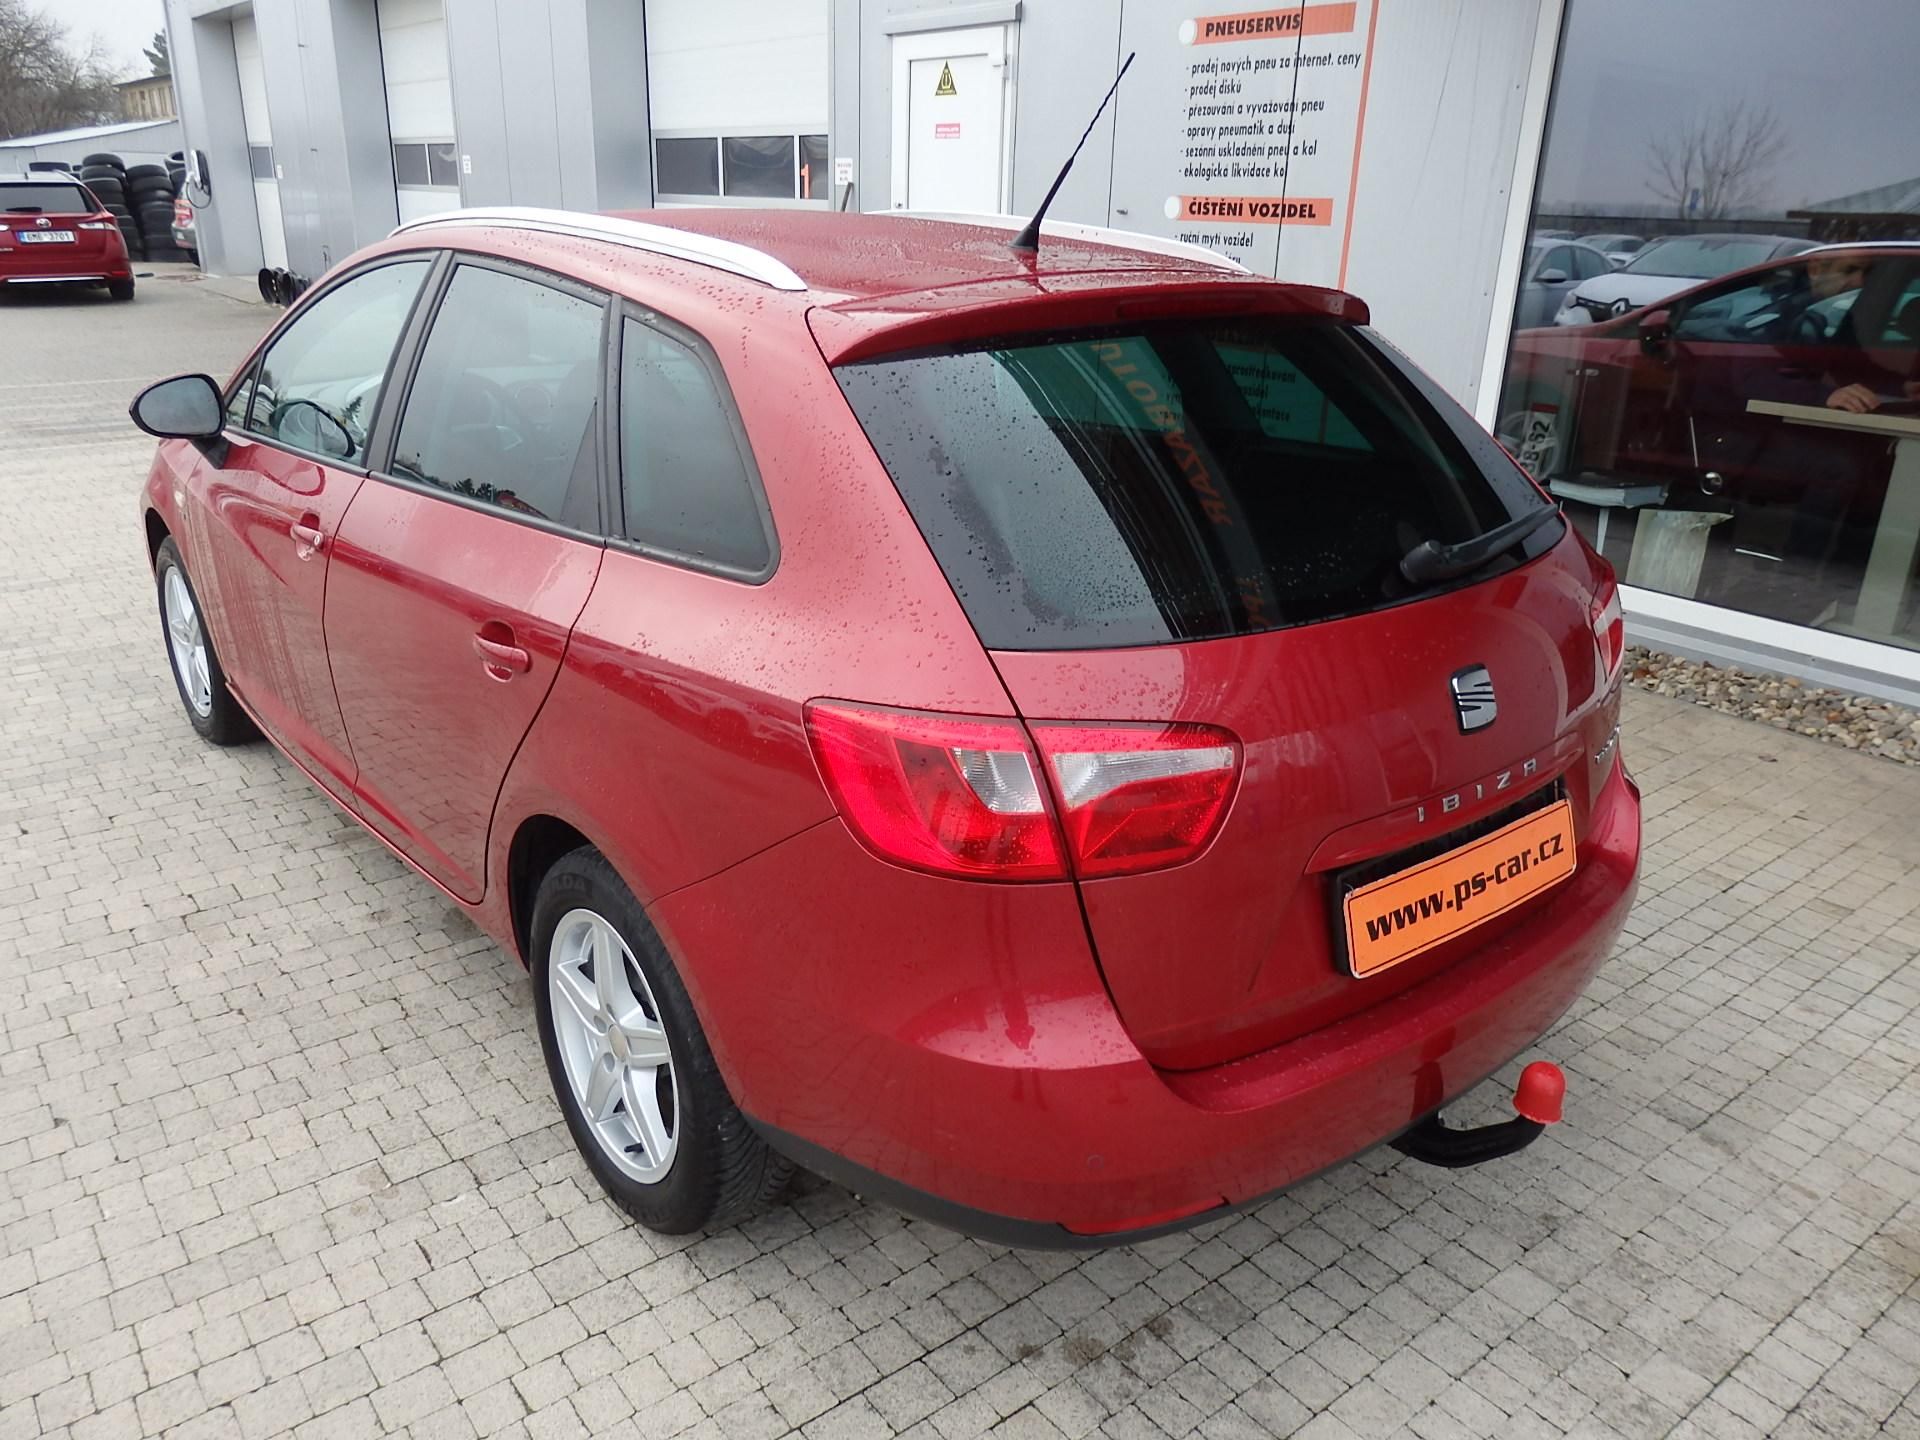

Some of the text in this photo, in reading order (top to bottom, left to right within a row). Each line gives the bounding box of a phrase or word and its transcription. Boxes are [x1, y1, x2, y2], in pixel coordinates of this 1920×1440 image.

[1205, 13, 1301, 37] PNEUSERVIS
[1191, 57, 1218, 78] prodej
[1220, 56, 1251, 75] nových
[1254, 57, 1276, 74] pneu
[1279, 57, 1290, 69] za
[1337, 53, 1361, 69] ceny
[1190, 79, 1216, 100] prodej
[1237, 104, 1243, 114] a
[1301, 100, 1325, 116] pneu
[1187, 126, 1216, 141] opravy
[1218, 120, 1264, 141] pneumatik
[1268, 124, 1274, 135] a
[1267, 145, 1288, 160] pneu
[1292, 145, 1299, 156] a
[1302, 139, 1318, 156] kol
[1231, 161, 1271, 178] likvidace
[1273, 161, 1287, 178] ko
[1189, 197, 1316, 219] ČIŠTĚNÍ VOZIDEL
[1223, 231, 1253, 247] vozidel
[1417, 758, 1537, 822] IBIZA
[1366, 832, 1564, 942] www.ps-car.cz
